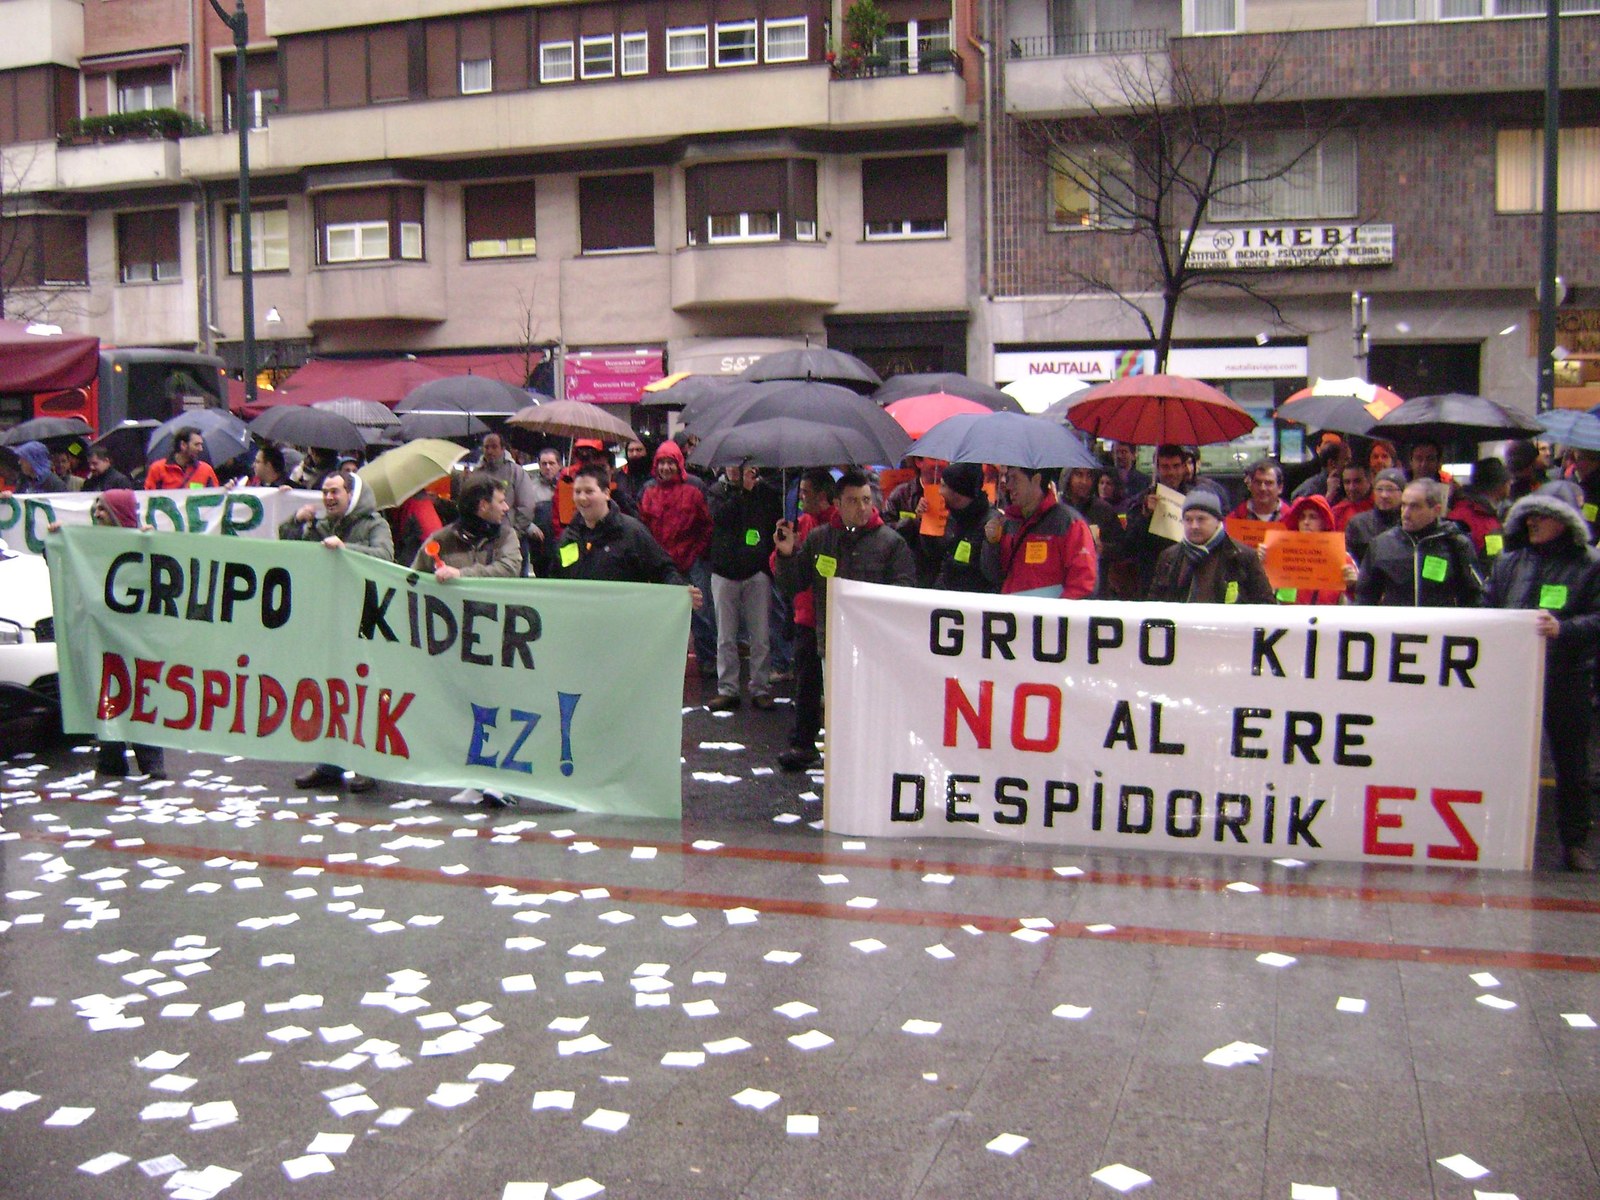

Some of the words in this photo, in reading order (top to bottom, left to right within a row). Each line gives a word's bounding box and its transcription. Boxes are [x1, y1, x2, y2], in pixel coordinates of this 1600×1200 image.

[1186, 250, 1227, 260] NSTITUTO
[1242, 227, 1358, 247] IMEBI
[1029, 361, 1102, 376] NAUTALIA
[103, 551, 293, 629] GRUPO
[930, 608, 1176, 666] GRUPO
[943, 677, 1063, 754] NO
[1103, 700, 1186, 756] AL
[1232, 707, 1375, 767] ERE
